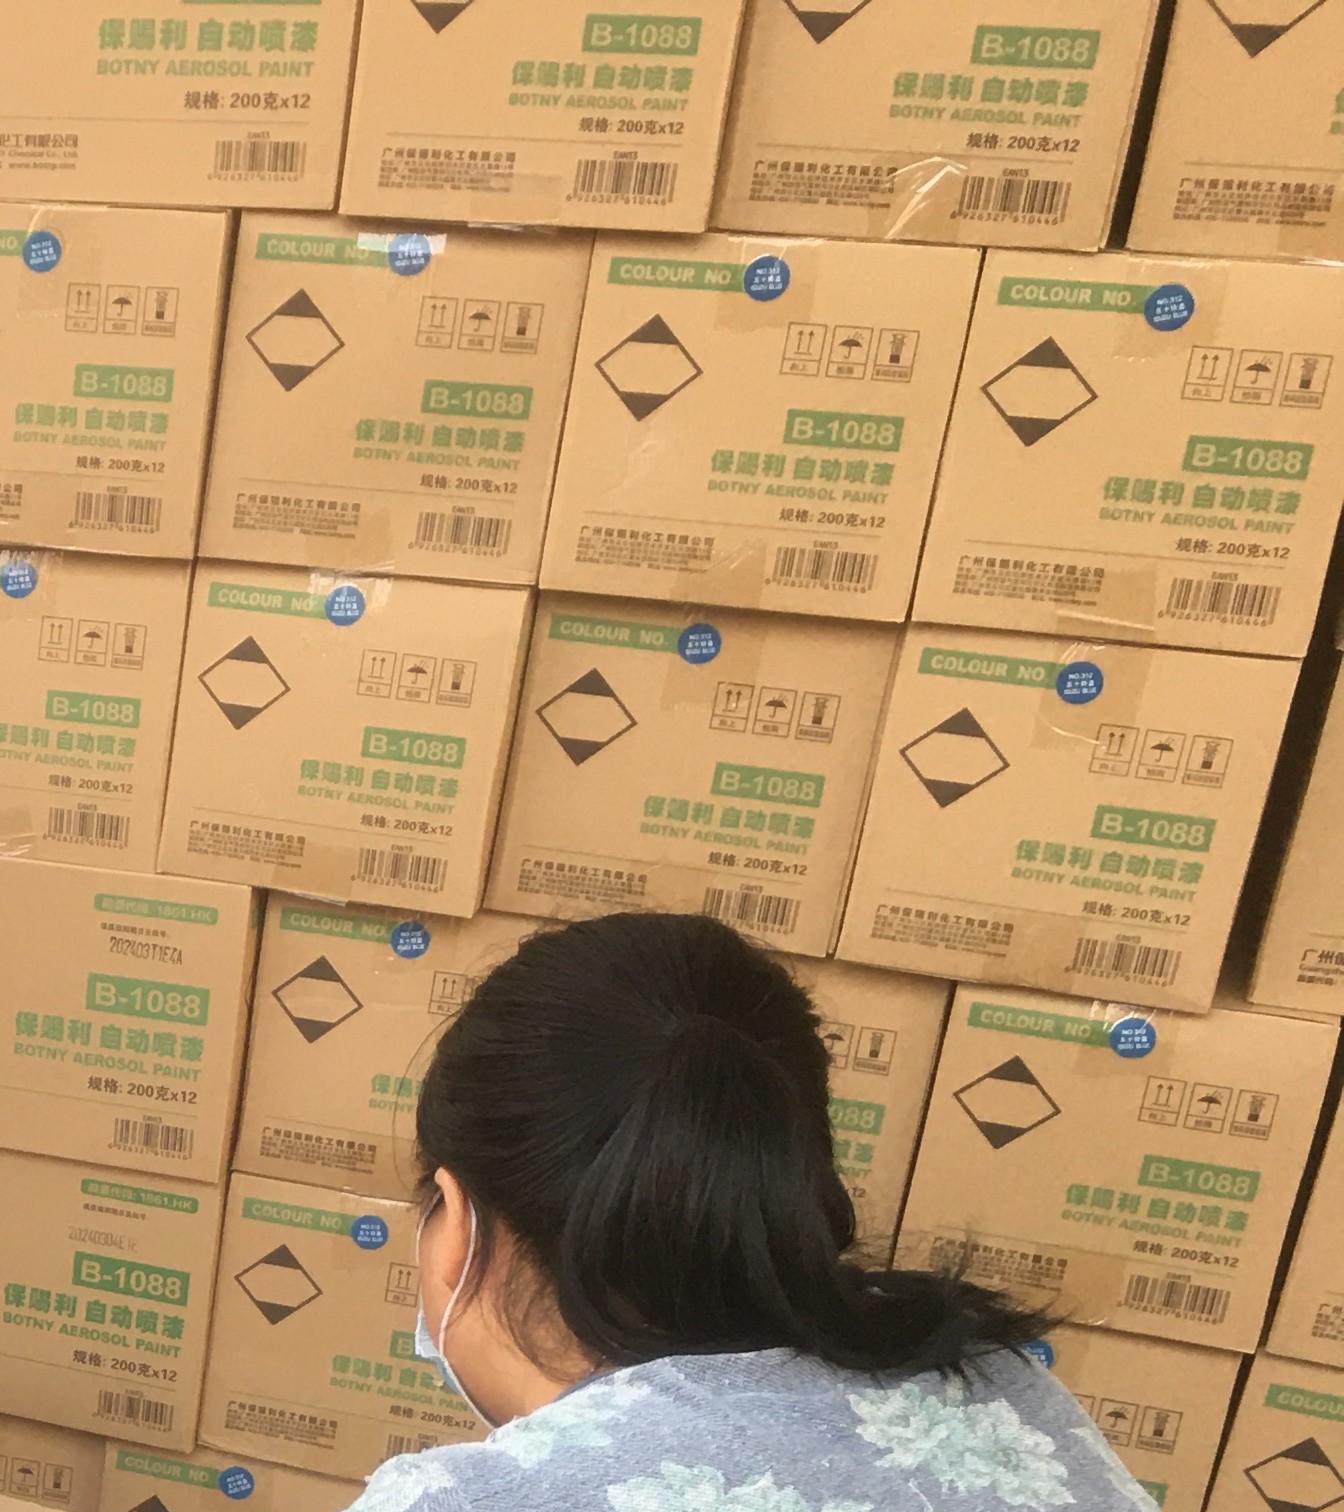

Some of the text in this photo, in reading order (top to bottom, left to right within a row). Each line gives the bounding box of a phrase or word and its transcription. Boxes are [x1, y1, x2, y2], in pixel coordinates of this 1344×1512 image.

[197, 18, 319, 52] 自动喷漆
[590, 23, 692, 48] B-1088
[979, 34, 1089, 62] B-1088
[97, 59, 315, 77] BOTNY AEROSOL PAINT
[229, 91, 311, 110] 200克x12
[265, 238, 335, 258] COLOUR
[618, 261, 695, 283] COLOUR
[1009, 282, 1093, 304] COLOUR
[79, 370, 165, 396] B-1088
[428, 386, 523, 414] B-1088
[791, 416, 894, 446] B-1088
[1190, 443, 1303, 474] B-1088
[216, 587, 281, 609] COLOUR
[558, 618, 630, 641] COLOUR
[928, 654, 1006, 679] COLOUR
[52, 696, 133, 723] B-1088
[368, 732, 457, 763] B-1088
[719, 768, 816, 801] B-1088
[1097, 813, 1204, 847] B-1088
[290, 911, 353, 933] COLOUR
[95, 981, 200, 1019] B-1088
[979, 1006, 1056, 1032] COLOUR
[13, 1041, 200, 1081] BOTNY AEROSOL PAINT
[1146, 1160, 1251, 1196] B-1088
[251, 1201, 313, 1224] COLOUR
[80, 1259, 181, 1300] B-1088
[2, 1311, 181, 1359] BOTNY AEROSOL PAINT
[124, 1456, 181, 1478] COLOUR
